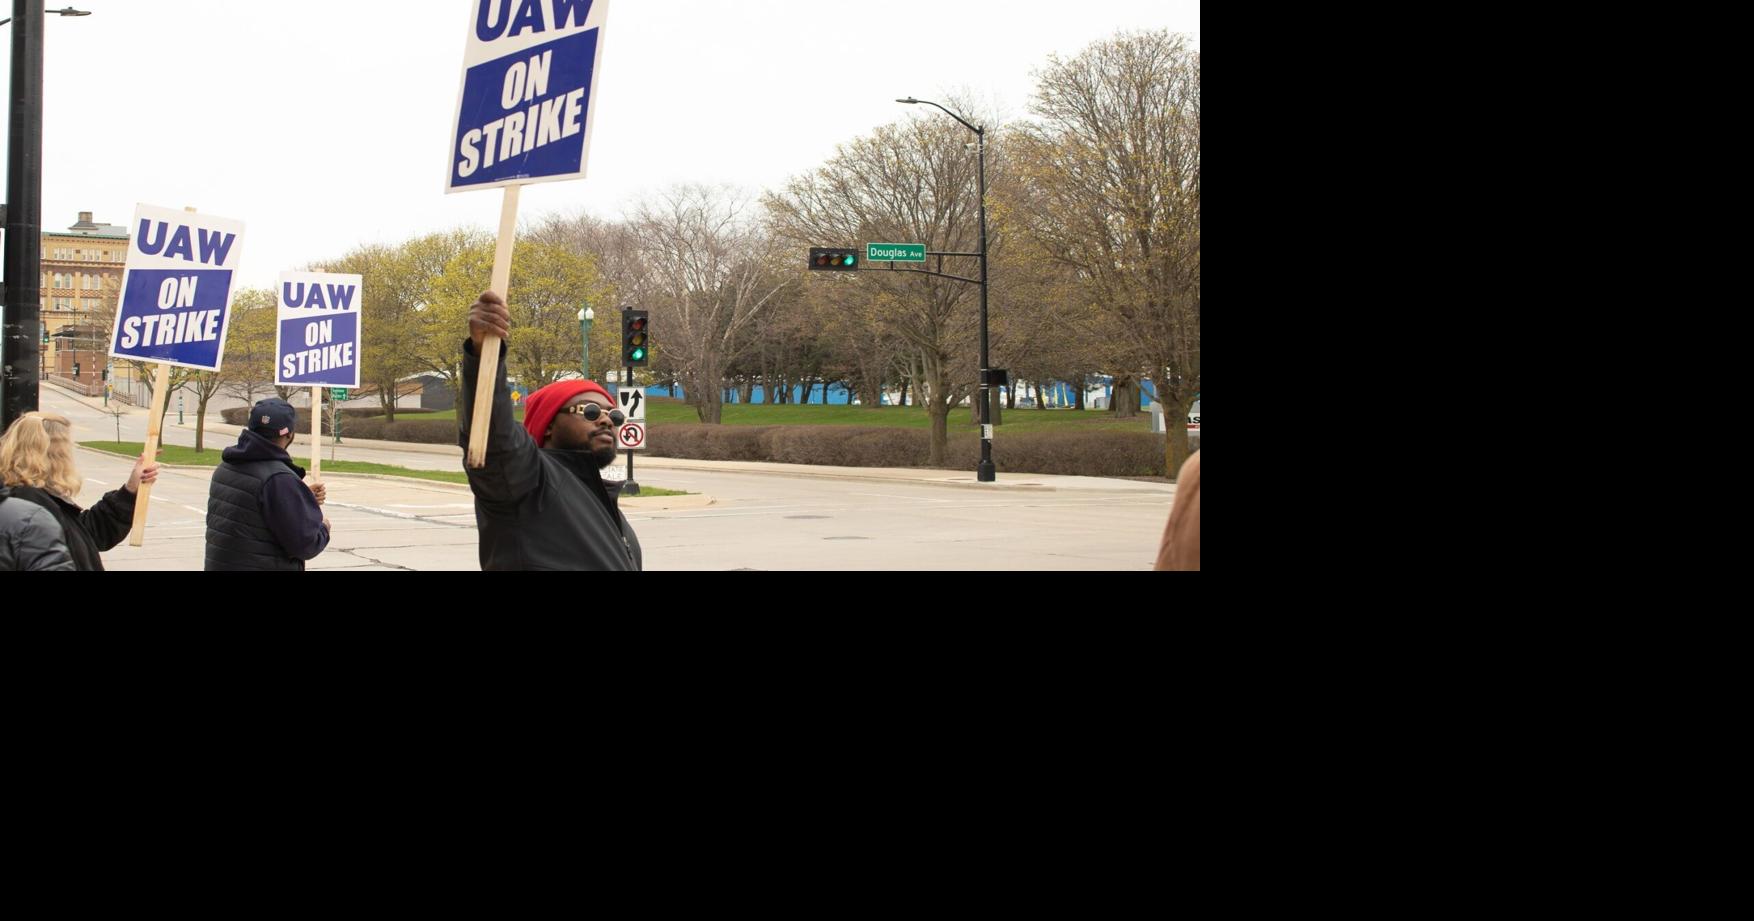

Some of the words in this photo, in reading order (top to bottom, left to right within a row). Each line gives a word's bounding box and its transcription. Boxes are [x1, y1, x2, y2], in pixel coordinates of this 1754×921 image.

[476, 0, 594, 42] UAW
[501, 49, 552, 110] ON
[458, 87, 585, 178] STRIKE
[137, 218, 236, 266] UAW
[870, 247, 907, 259] Douglas
[158, 276, 198, 310] ON
[283, 282, 355, 310] UAW
[121, 309, 220, 349] STRIKE
[305, 319, 333, 346] ON
[283, 342, 353, 379] STRIKE
